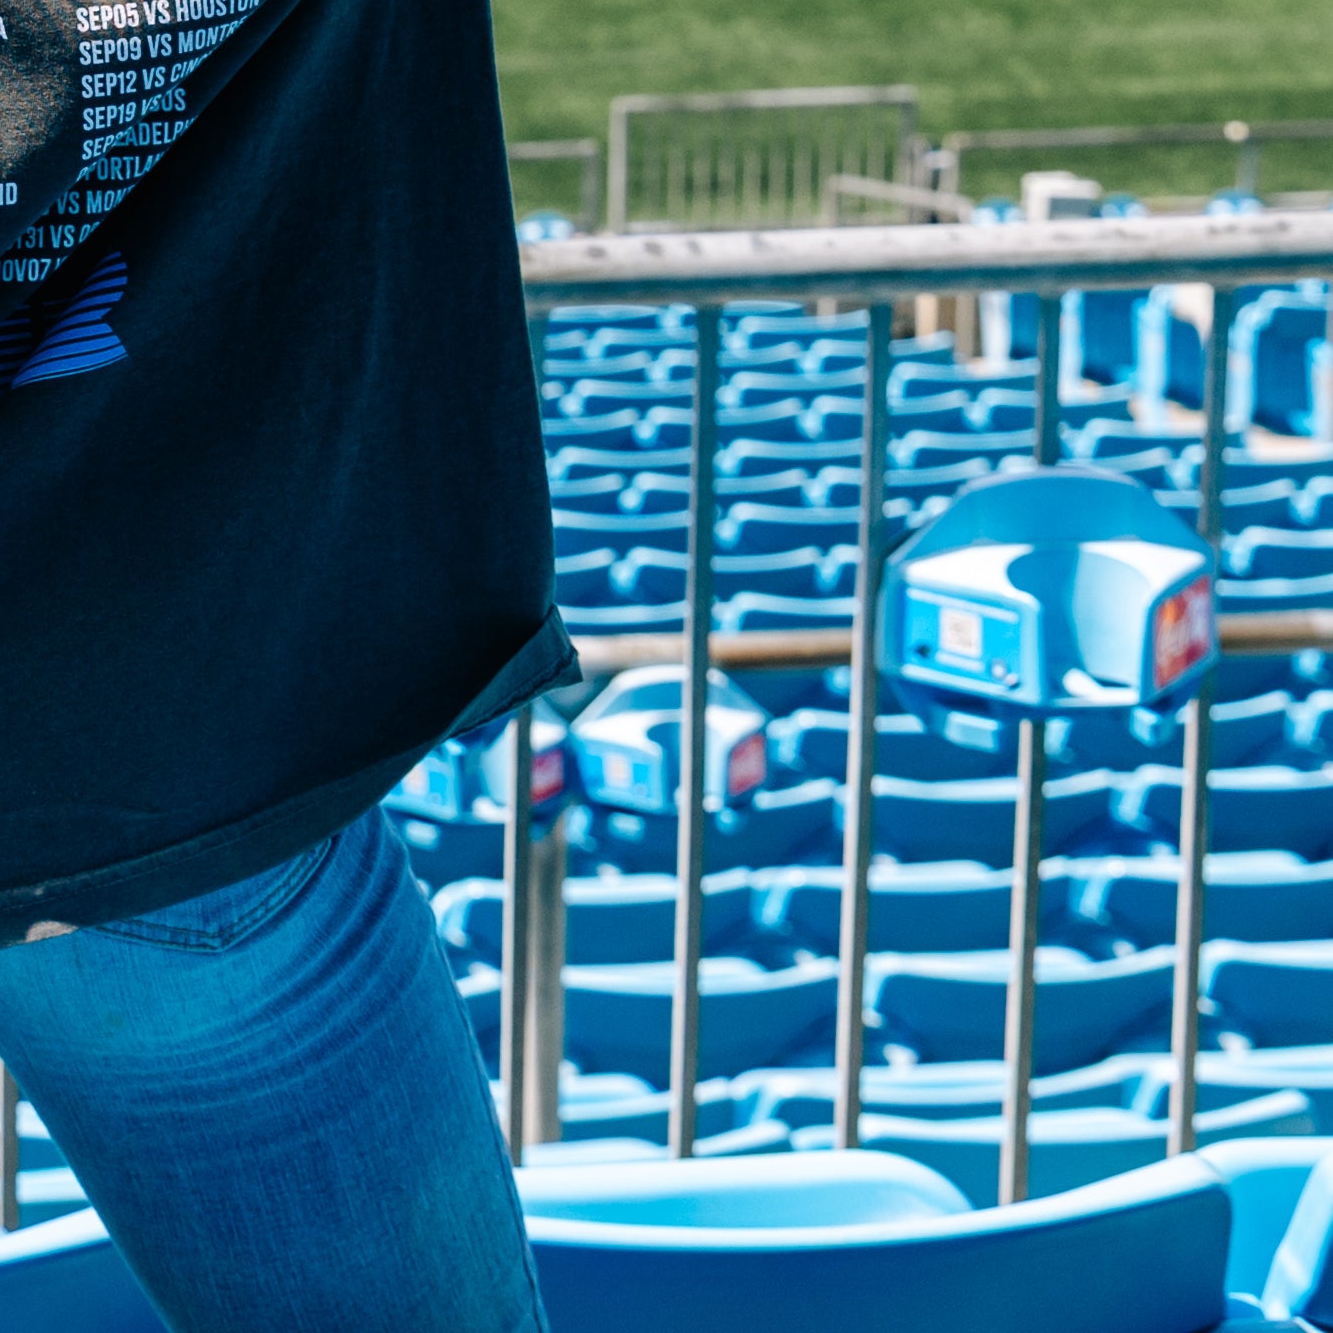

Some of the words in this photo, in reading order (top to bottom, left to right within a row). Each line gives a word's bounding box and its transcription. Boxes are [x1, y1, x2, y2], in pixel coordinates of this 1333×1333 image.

[76, 2, 139, 33] SEP05
[79, 36, 141, 65] SEP09
[147, 33, 172, 59] VS
[81, 70, 137, 99] SEP12
[142, 66, 166, 90] VS
[82, 102, 136, 131] SEP19
[56, 191, 80, 215] VS
[50, 224, 75, 249] VS
